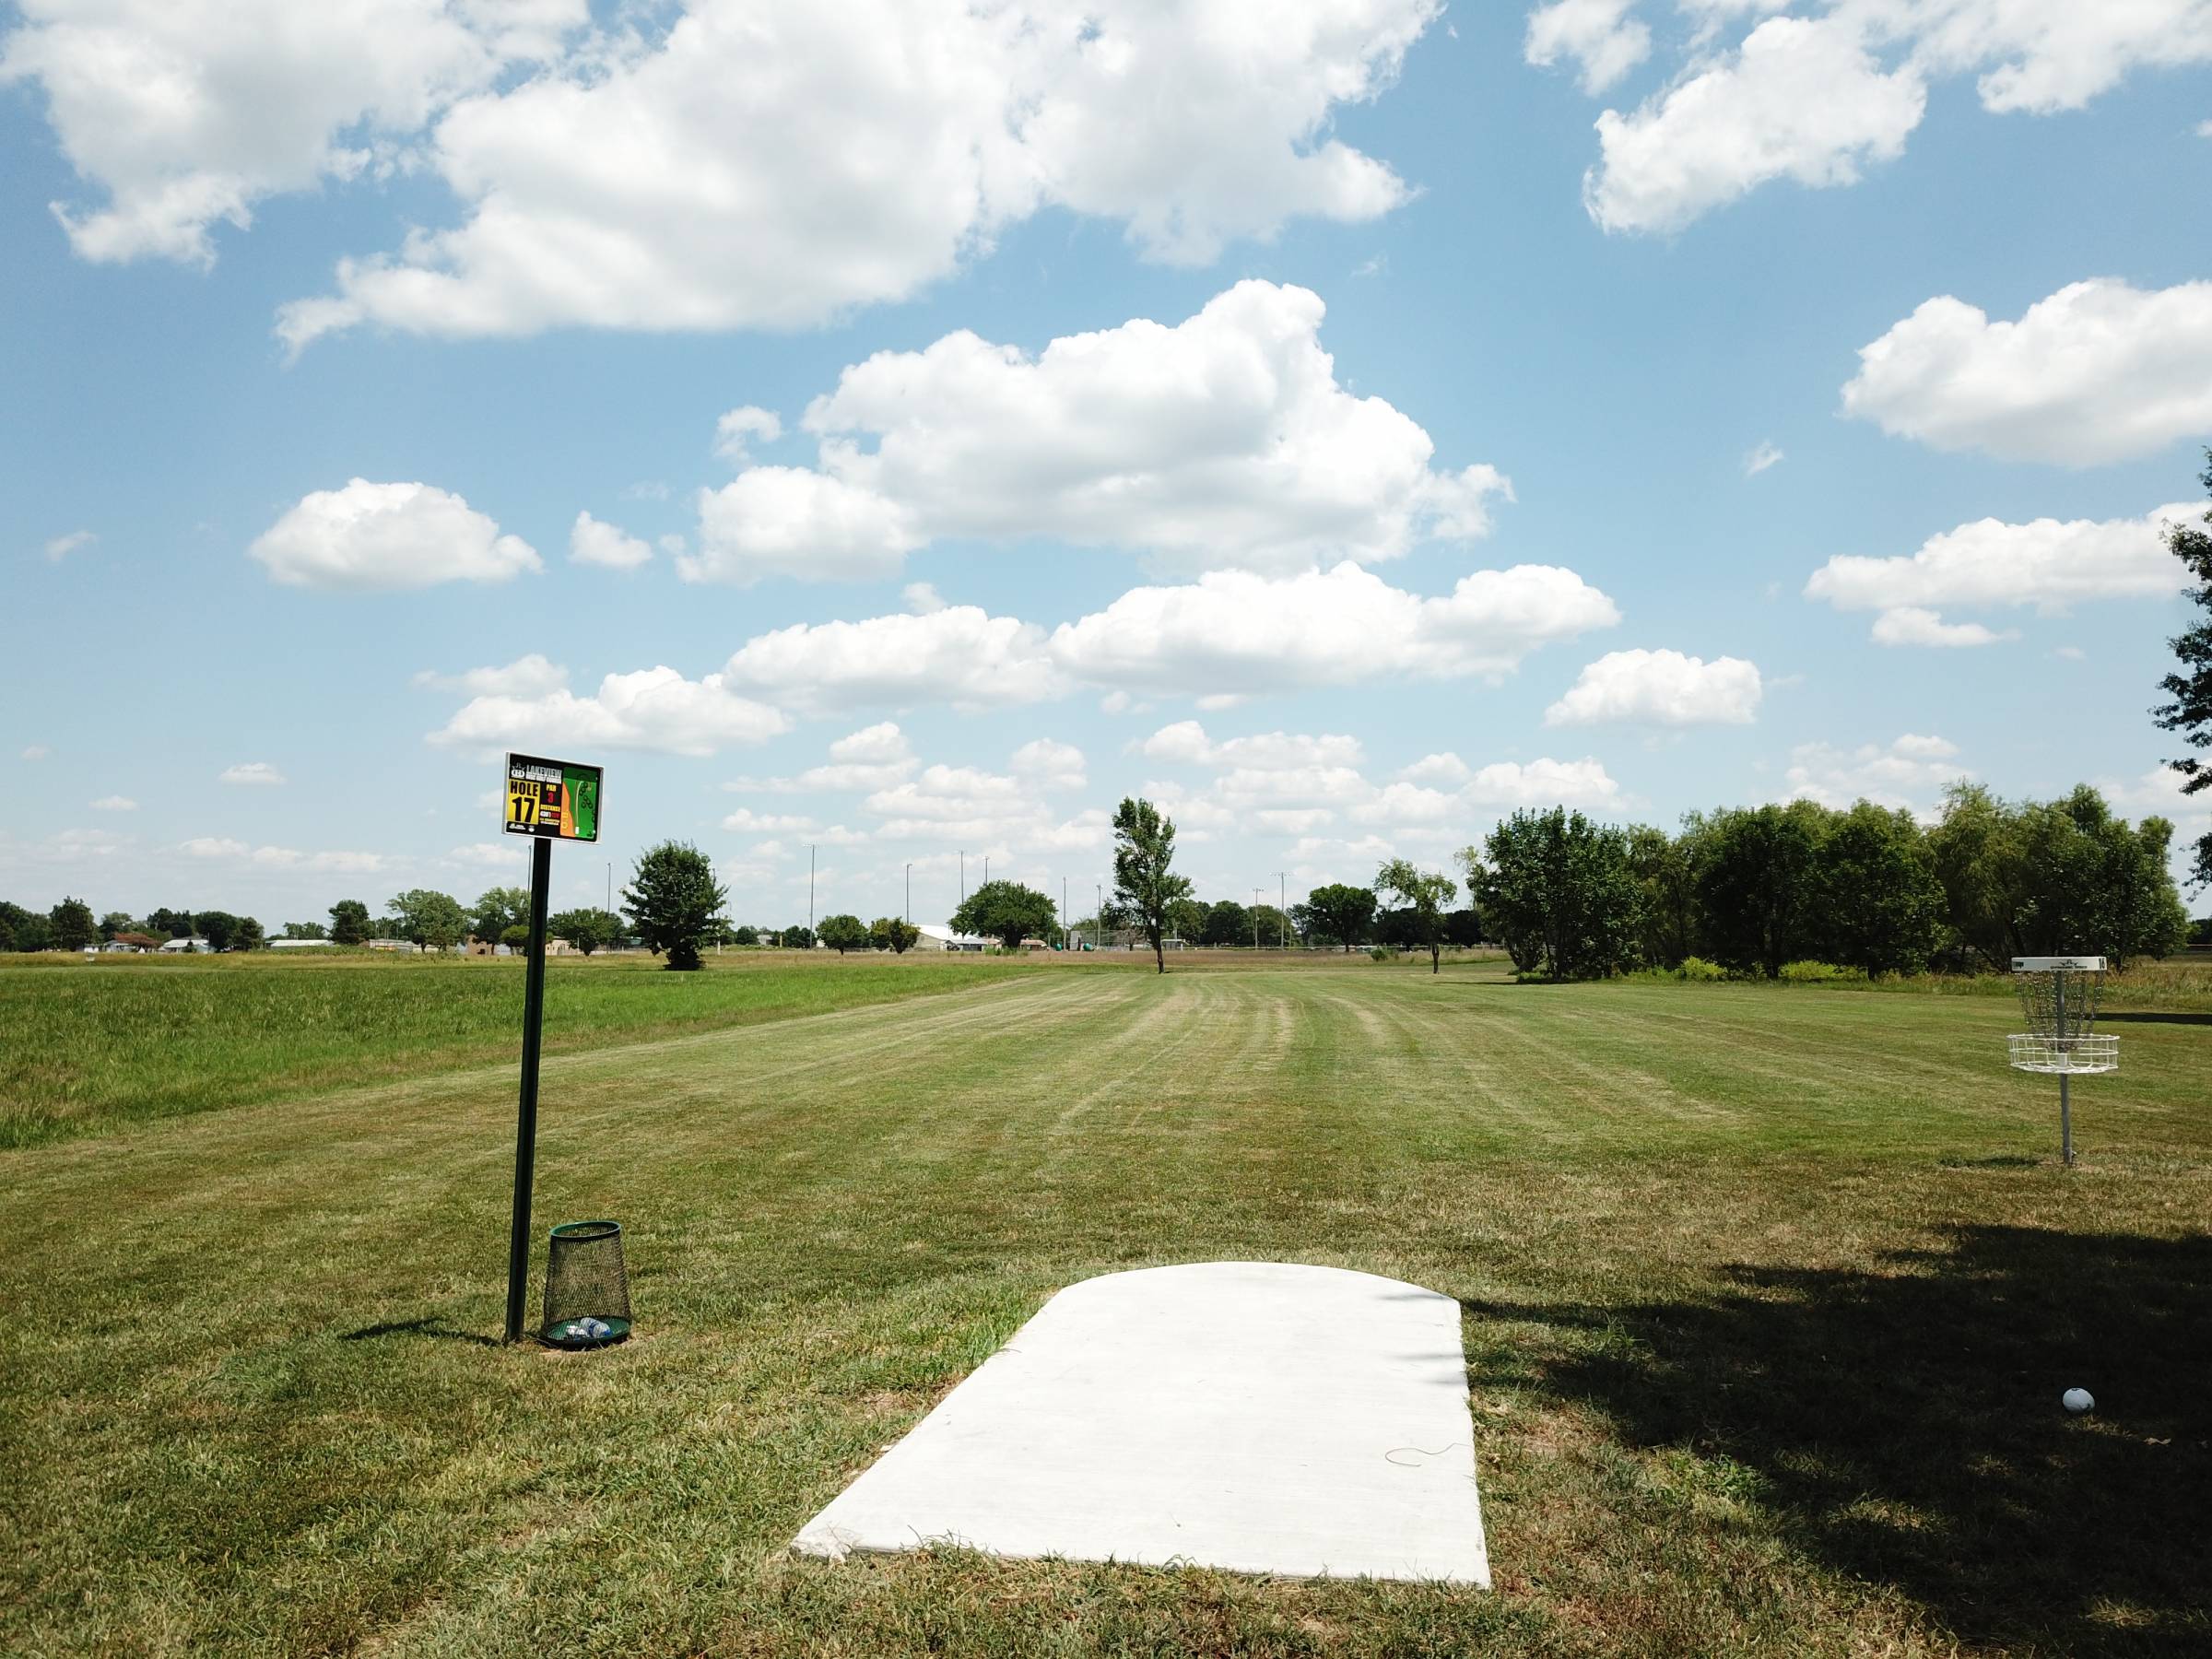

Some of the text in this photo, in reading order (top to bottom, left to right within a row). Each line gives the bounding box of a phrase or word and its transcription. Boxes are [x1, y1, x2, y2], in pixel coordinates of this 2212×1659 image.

[526, 764, 562, 779] LAKEVIEW
[510, 781, 538, 797] HOLE
[512, 796, 535, 823] 17
